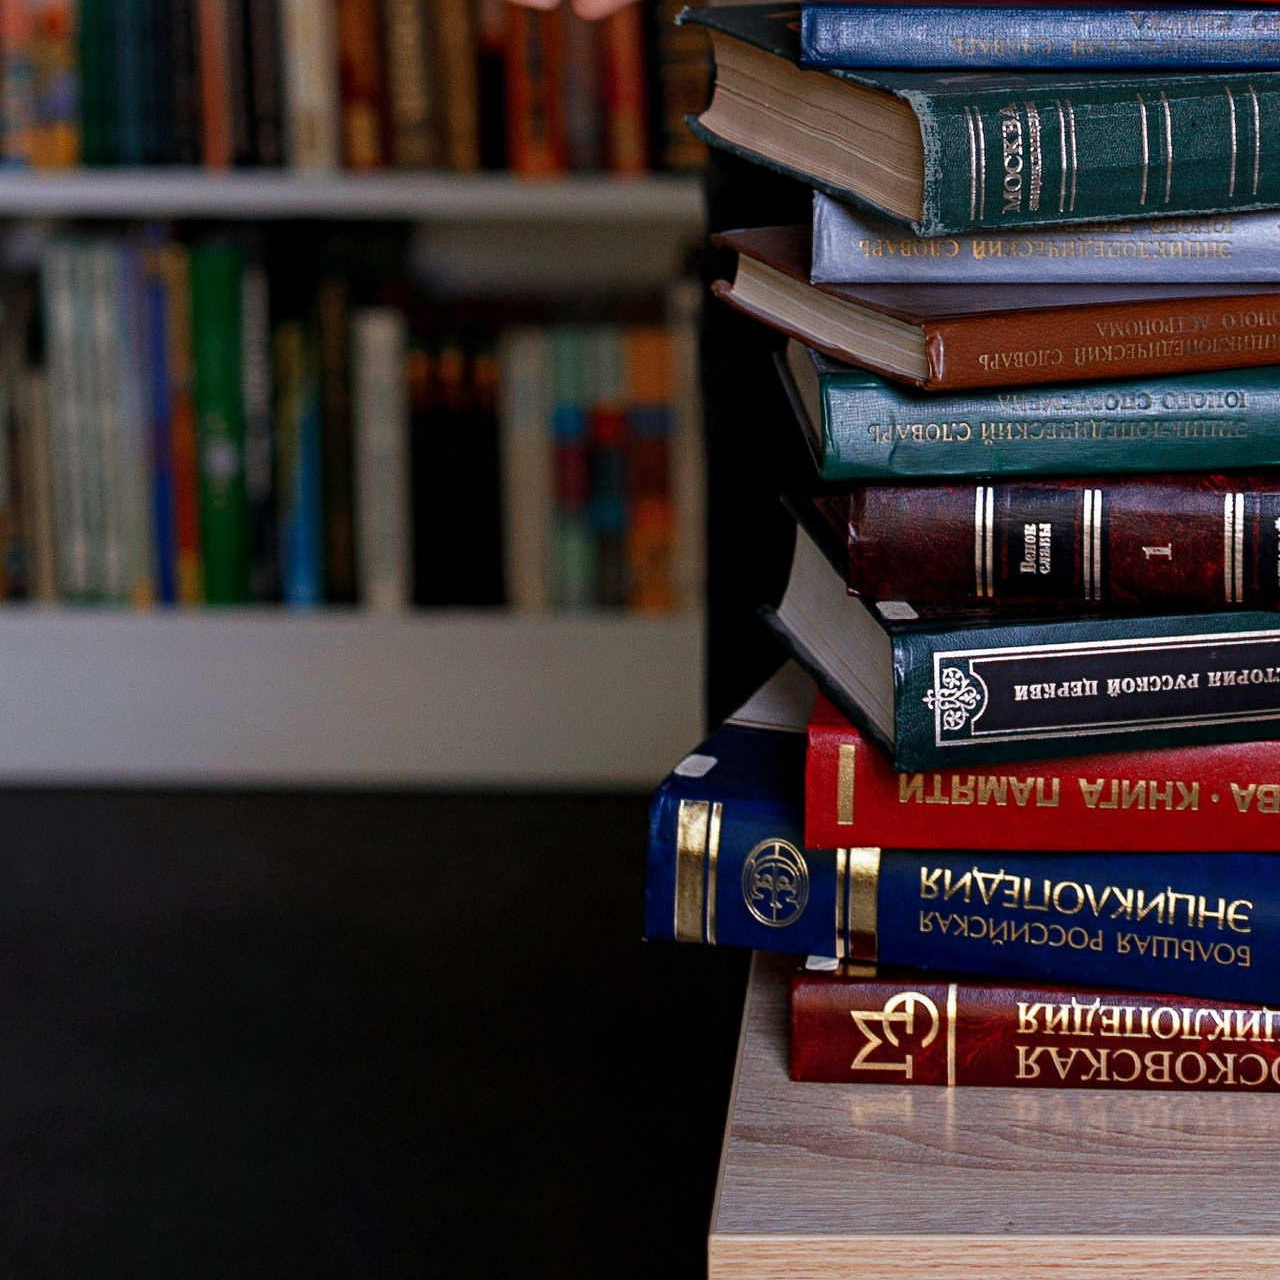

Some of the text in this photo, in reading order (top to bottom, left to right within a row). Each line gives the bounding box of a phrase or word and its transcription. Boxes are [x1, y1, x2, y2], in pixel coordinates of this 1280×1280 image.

[1000, 101, 1024, 215] МОСКВА
[858, 239, 1234, 260] ЭНЦИКЛОПЕДИЧЕСКИЙ СЛОВАРЬ
[1095, 314, 1210, 338] АСТРОНОМА
[978, 348, 1064, 371] СЛОВАРЬ
[1162, 390, 1247, 410] ЮНОГО
[867, 421, 972, 443] СЛОВАРЬ
[1141, 542, 1172, 561] 1
[1013, 677, 1099, 702] ЦЕРКВИ
[1106, 673, 1200, 697] РУССКОЙ
[898, 772, 1061, 808] ПАМЯТИ
[1077, 777, 1200, 811] КНИГА
[919, 866, 1254, 933] ЭНЦИКЛОПЕДИЯ
[919, 910, 1251, 967] БОЛЬШАЯ РОССИЙСКАЯ
